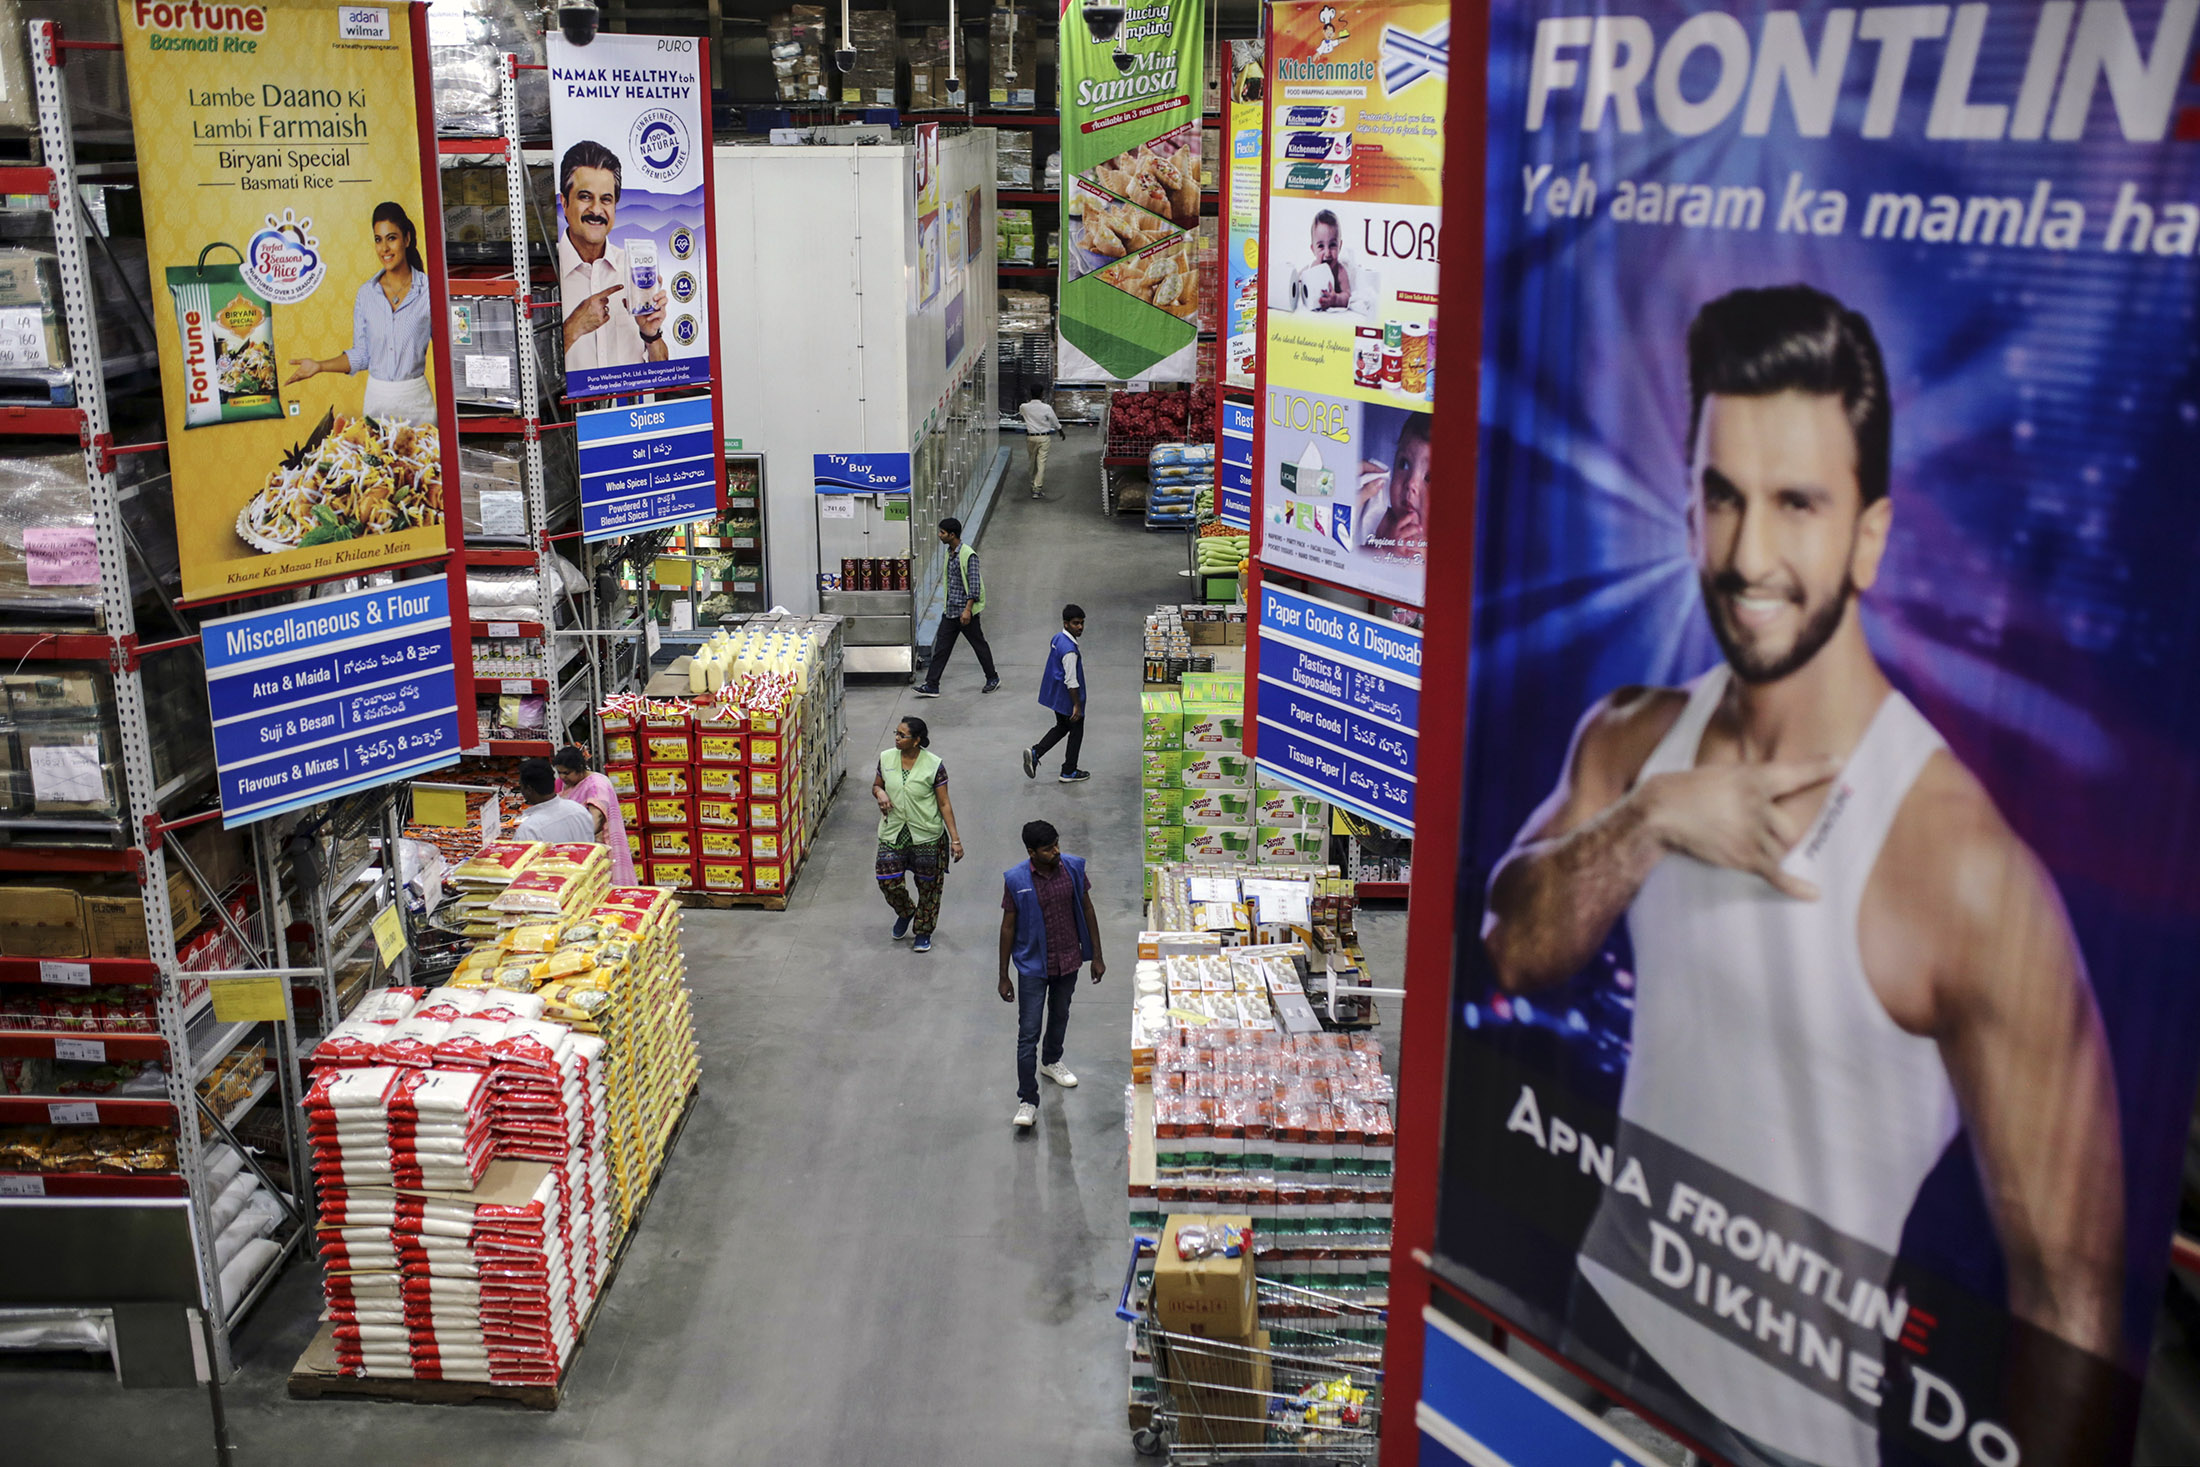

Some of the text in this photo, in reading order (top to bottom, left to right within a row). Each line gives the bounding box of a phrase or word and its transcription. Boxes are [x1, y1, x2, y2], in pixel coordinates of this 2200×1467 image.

[135, 0, 265, 32] Fortune
[349, 10, 379, 24] adani
[346, 25, 384, 37] wilmar
[150, 33, 258, 53] Basmati Rice
[657, 40, 692, 52] PURO
[1120, 50, 1178, 77] Mini
[1278, 58, 1374, 81] Kitchenmate
[1525, 0, 2200, 142] FRONTLIN
[552, 68, 695, 83] NAMAK HEALTHY toh
[189, 84, 366, 108] Lambe Daano Ki
[568, 85, 690, 99] FAMILY HEALTHY
[1077, 69, 1178, 106] Samosa
[636, 112, 674, 132] UNREFINED
[1091, 99, 1182, 130] Available in 3 new variants
[1288, 116, 1322, 124] Kitchenmate
[193, 112, 367, 139] Lambi Farmaish
[640, 136, 680, 156] NATURAL
[648, 131, 668, 143] 100%
[1288, 145, 1325, 154] Kitchenmate
[219, 148, 350, 174] Biryani Special
[642, 150, 687, 180] CHEMICAL FREE
[241, 174, 334, 191] Basmati Rice
[1288, 174, 1324, 184] Kitchenmate
[1523, 162, 2087, 252] Yeh aaram ka mamla
[261, 243, 284, 252] Perfect
[1364, 218, 1436, 263] LIOR
[259, 252, 272, 274] 3
[270, 254, 303, 265] Seasons
[634, 256, 654, 264] PURO
[272, 264, 298, 278] Rice
[225, 309, 257, 319] BIRYANI
[229, 317, 254, 325] SPECIAL
[1232, 340, 1244, 348] New
[185, 310, 210, 405] Fortune
[587, 364, 690, 383] Puro Wellness Ltd. Recognised Under
[622, 375, 671, 387] Programme Govt.
[630, 410, 666, 430] Spices
[1235, 410, 1254, 428] Rest
[1270, 393, 1349, 438] LIORA
[632, 449, 646, 460] Salt
[828, 454, 848, 466] Try
[849, 463, 872, 474] Buy
[606, 476, 648, 492] Whole Spices
[868, 474, 897, 483] Save
[608, 498, 648, 514] Powdered &
[600, 510, 648, 526] Blended Spices
[1367, 534, 1416, 550] Hygiene is as
[227, 541, 410, 584] Khane Ka Mazaa Hai Khilane Mein
[1384, 552, 1410, 568] Always
[226, 594, 430, 656] Miscellaneous & Flour
[1268, 596, 1422, 666] Paper Goods & Disposab
[344, 644, 442, 674] గోధుమ పిండి & మైదా
[1299, 653, 1342, 681] Plastics &
[253, 668, 331, 698] Atta & Maida
[1292, 667, 1342, 698] Disposables
[1378, 679, 1386, 692] &
[352, 710, 362, 724] &
[1290, 702, 1342, 735] Paper Goods
[260, 714, 335, 743] Suji & Besan
[398, 736, 408, 750] &
[1288, 745, 1340, 778] Tissue Paper
[238, 756, 340, 795] Flavours & Mixes
[1506, 1083, 1938, 1356] APNA FRONTLINE
[1648, 1219, 1885, 1408] DIKHNE
